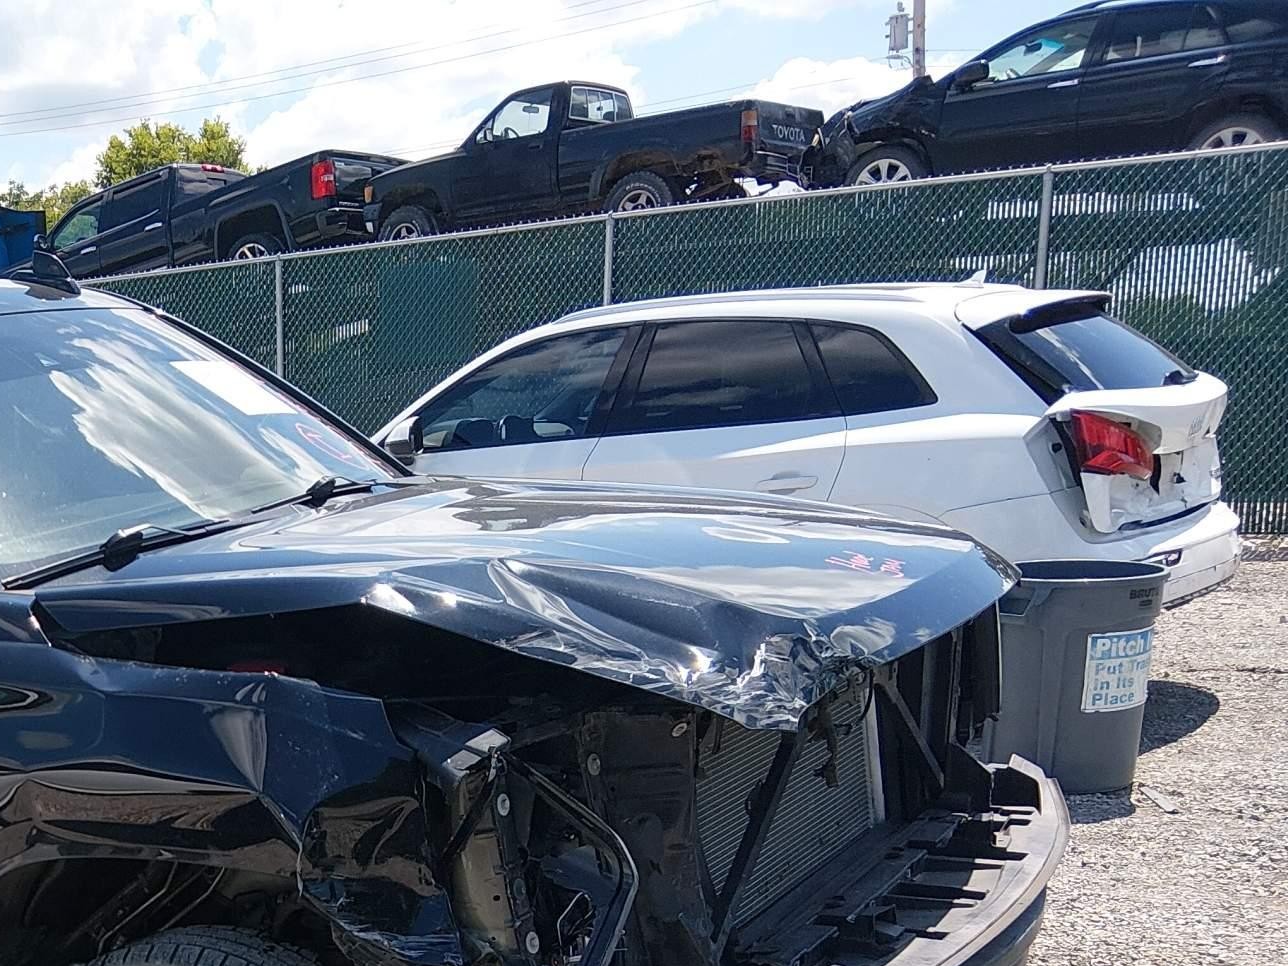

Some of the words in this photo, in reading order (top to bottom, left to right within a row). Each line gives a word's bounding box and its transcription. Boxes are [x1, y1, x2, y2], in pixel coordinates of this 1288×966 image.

[772, 124, 806, 142] TOYOTA
[1096, 635, 1145, 658] Pitch
[1095, 661, 1123, 676] Put
[1116, 676, 1134, 689] Its
[1092, 692, 1135, 706] Place
